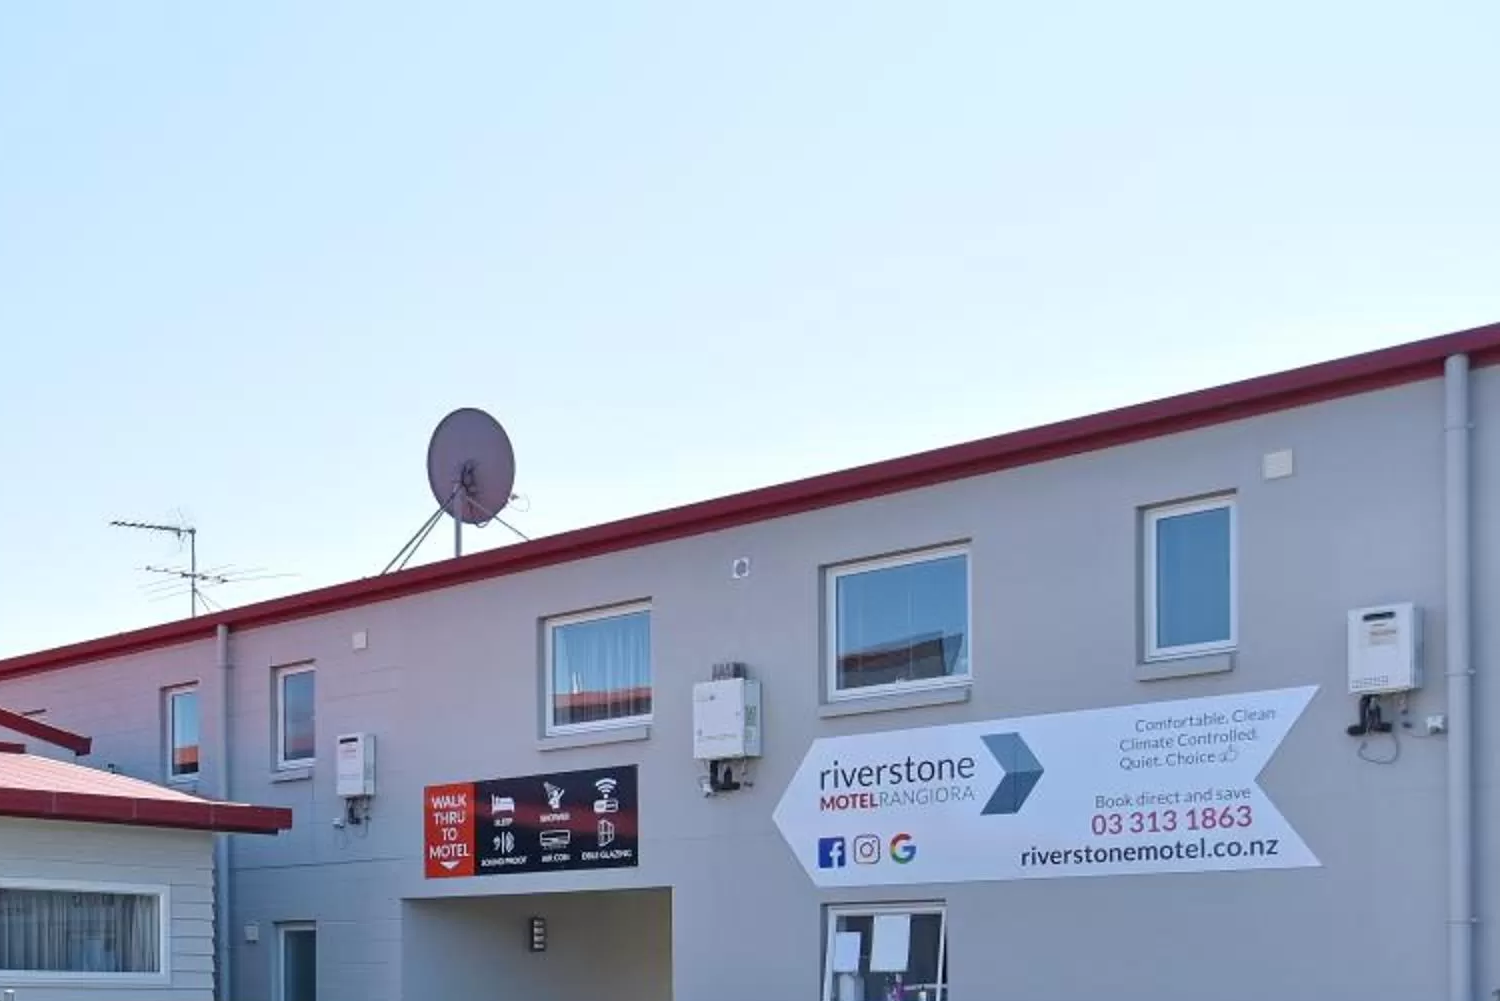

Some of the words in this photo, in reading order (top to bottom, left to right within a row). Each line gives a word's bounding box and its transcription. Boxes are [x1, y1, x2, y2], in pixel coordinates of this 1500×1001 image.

[1119, 736, 1174, 752] Climate
[1166, 751, 1215, 766] Choice
[820, 756, 975, 790] riverstone
[431, 793, 467, 809] WALK
[1095, 793, 1132, 809] Book
[1136, 790, 1180, 806] direct
[1183, 787, 1213, 803] and
[1215, 787, 1251, 802] save
[433, 810, 466, 825] THRU
[1091, 814, 1123, 835] 03
[1129, 810, 1177, 833] 313
[1186, 805, 1252, 830] 1863
[441, 826, 458, 841] TO
[429, 843, 469, 860] MOTEL
[1020, 837, 1279, 866] riverstonemotel.co.nz
